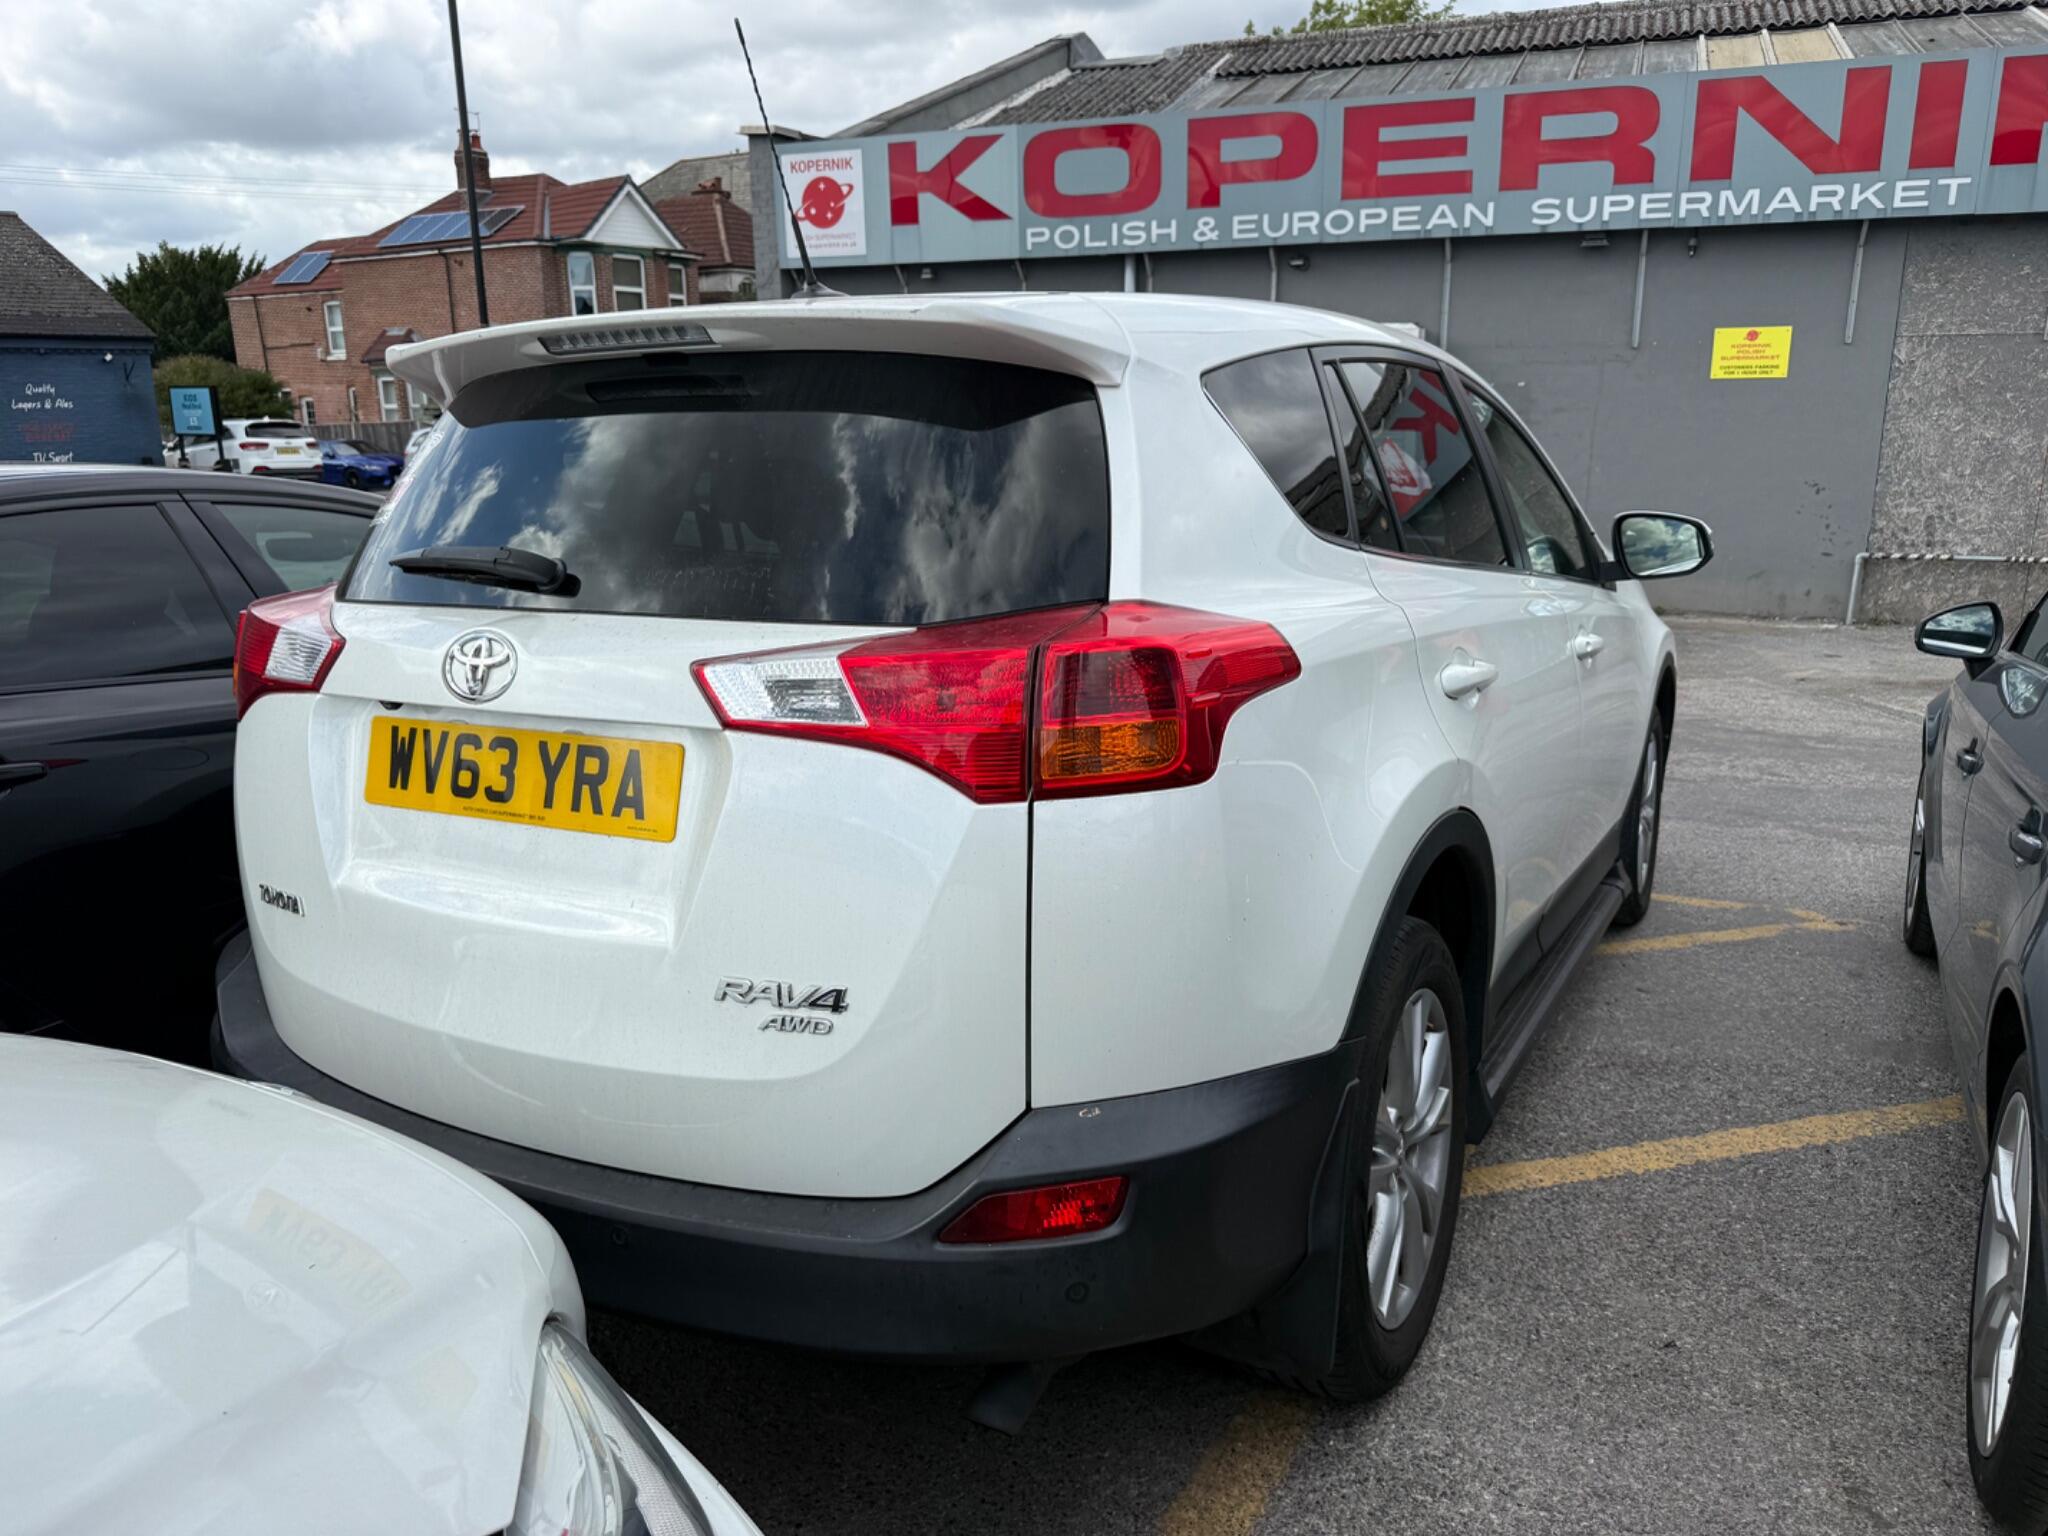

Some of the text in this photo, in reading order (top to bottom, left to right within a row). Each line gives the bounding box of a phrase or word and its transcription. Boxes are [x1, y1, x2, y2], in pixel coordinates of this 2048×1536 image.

[790, 157, 853, 174] KOPERNIK
[1026, 177, 1972, 251] POLISH & EUROPEAN SUPERMARKET
[25, 383, 55, 396] Quality
[11, 398, 41, 411] Lagers
[55, 397, 74, 409] Ales
[389, 725, 645, 820] WV63 YRA
[714, 976, 849, 1014] RAV4
[758, 1014, 834, 1036] AWD
